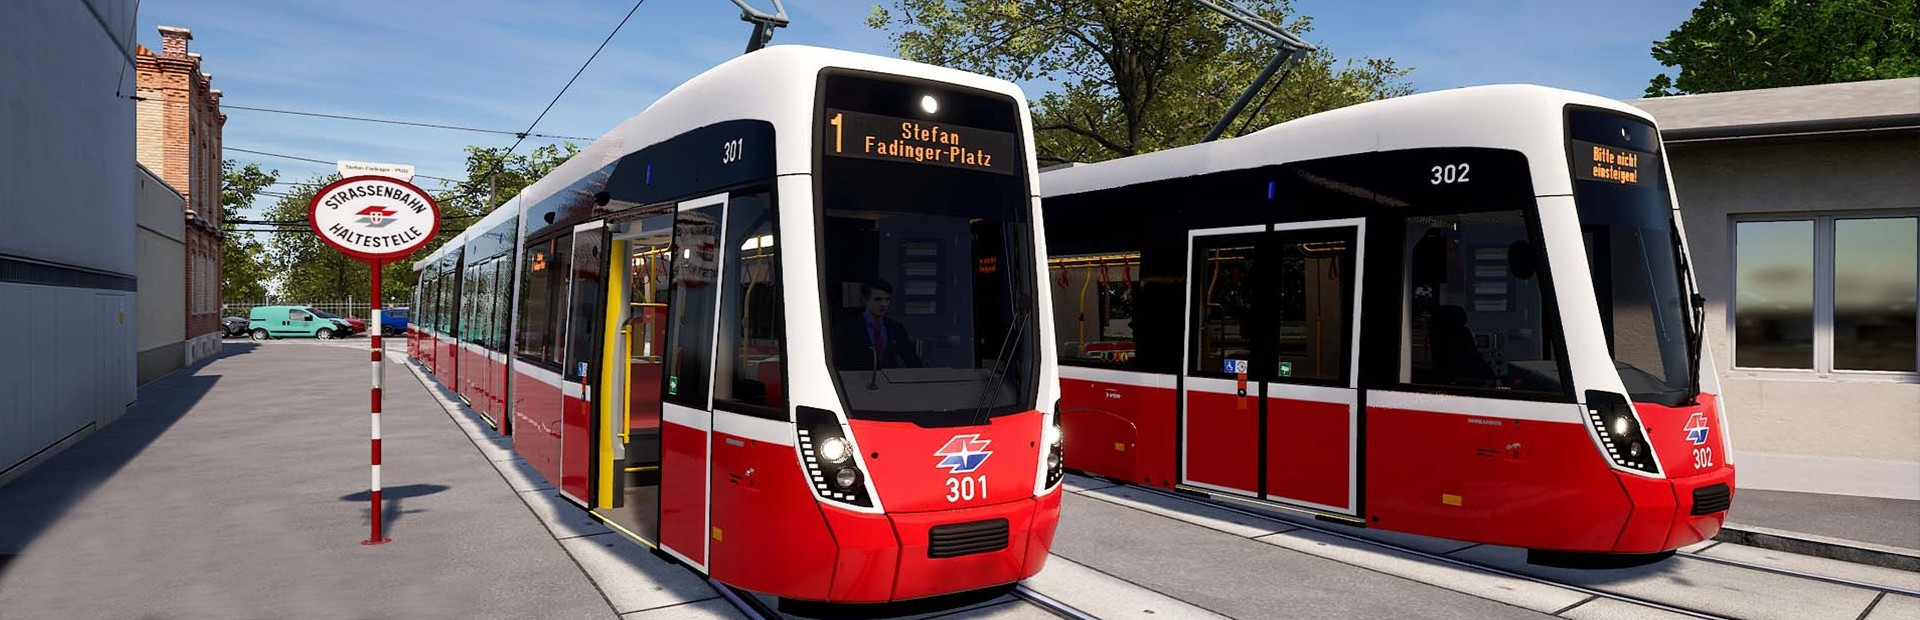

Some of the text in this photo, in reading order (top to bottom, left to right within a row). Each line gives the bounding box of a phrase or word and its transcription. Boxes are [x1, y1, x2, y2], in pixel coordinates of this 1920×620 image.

[830, 113, 843, 153] 1
[902, 122, 959, 146] Stefan
[723, 138, 744, 165] 301
[865, 136, 991, 167] Fadinger-Platz
[1593, 146, 1637, 168] Bitte nicht
[1431, 163, 1469, 185] 302
[1593, 163, 1637, 183] einsteigen!
[325, 185, 426, 214] STRASSENBAHN
[329, 223, 422, 248] HALTESTELLE
[1693, 448, 1713, 469] 302
[945, 475, 987, 502] 301
